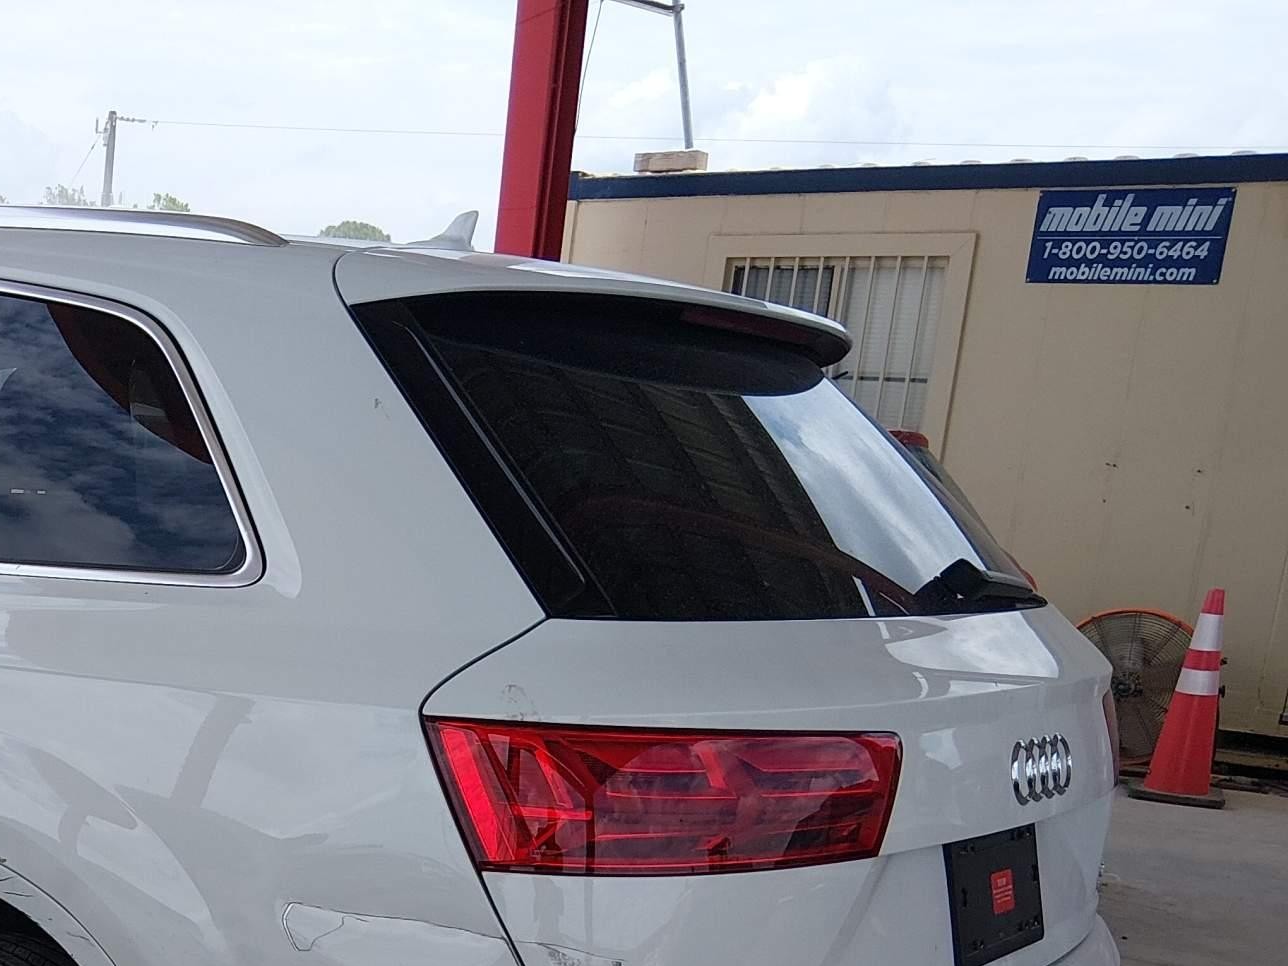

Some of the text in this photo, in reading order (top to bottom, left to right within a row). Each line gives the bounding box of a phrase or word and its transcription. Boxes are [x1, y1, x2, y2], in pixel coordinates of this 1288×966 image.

[1039, 193, 1227, 232] mobile mini
[1043, 240, 1211, 260] 1-800-950-6464
[1047, 263, 1197, 282] mobilemini.com
